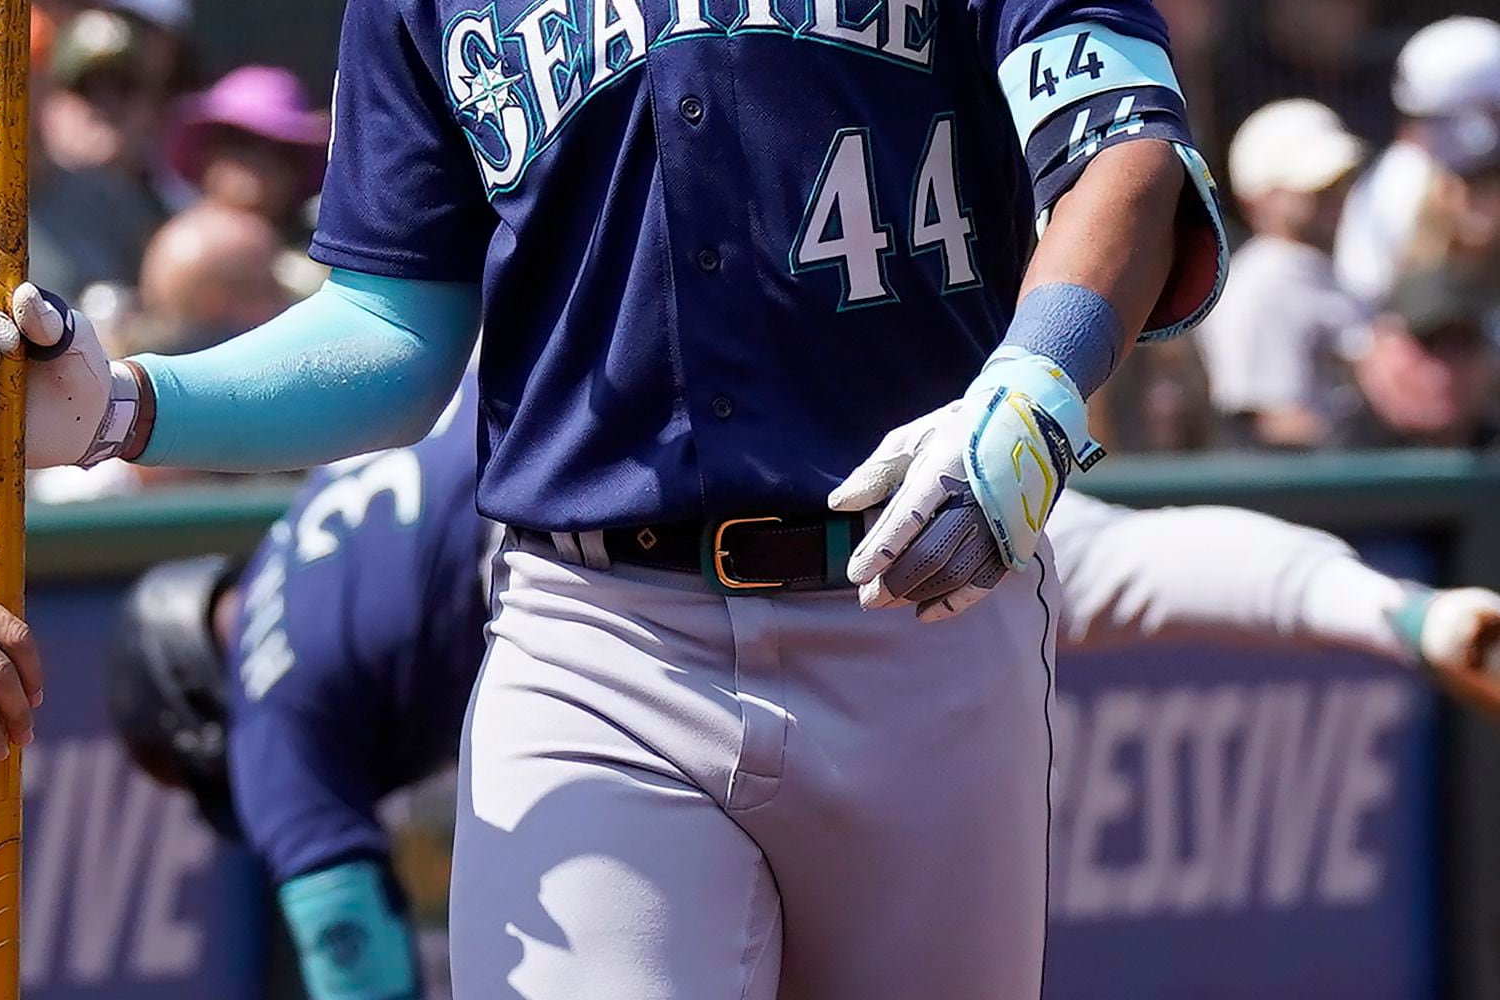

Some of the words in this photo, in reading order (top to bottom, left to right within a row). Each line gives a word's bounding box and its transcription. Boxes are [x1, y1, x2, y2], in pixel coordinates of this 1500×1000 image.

[1029, 31, 1105, 101] 44
[789, 112, 984, 312] 44
[1053, 680, 1405, 918] ESSIVE
